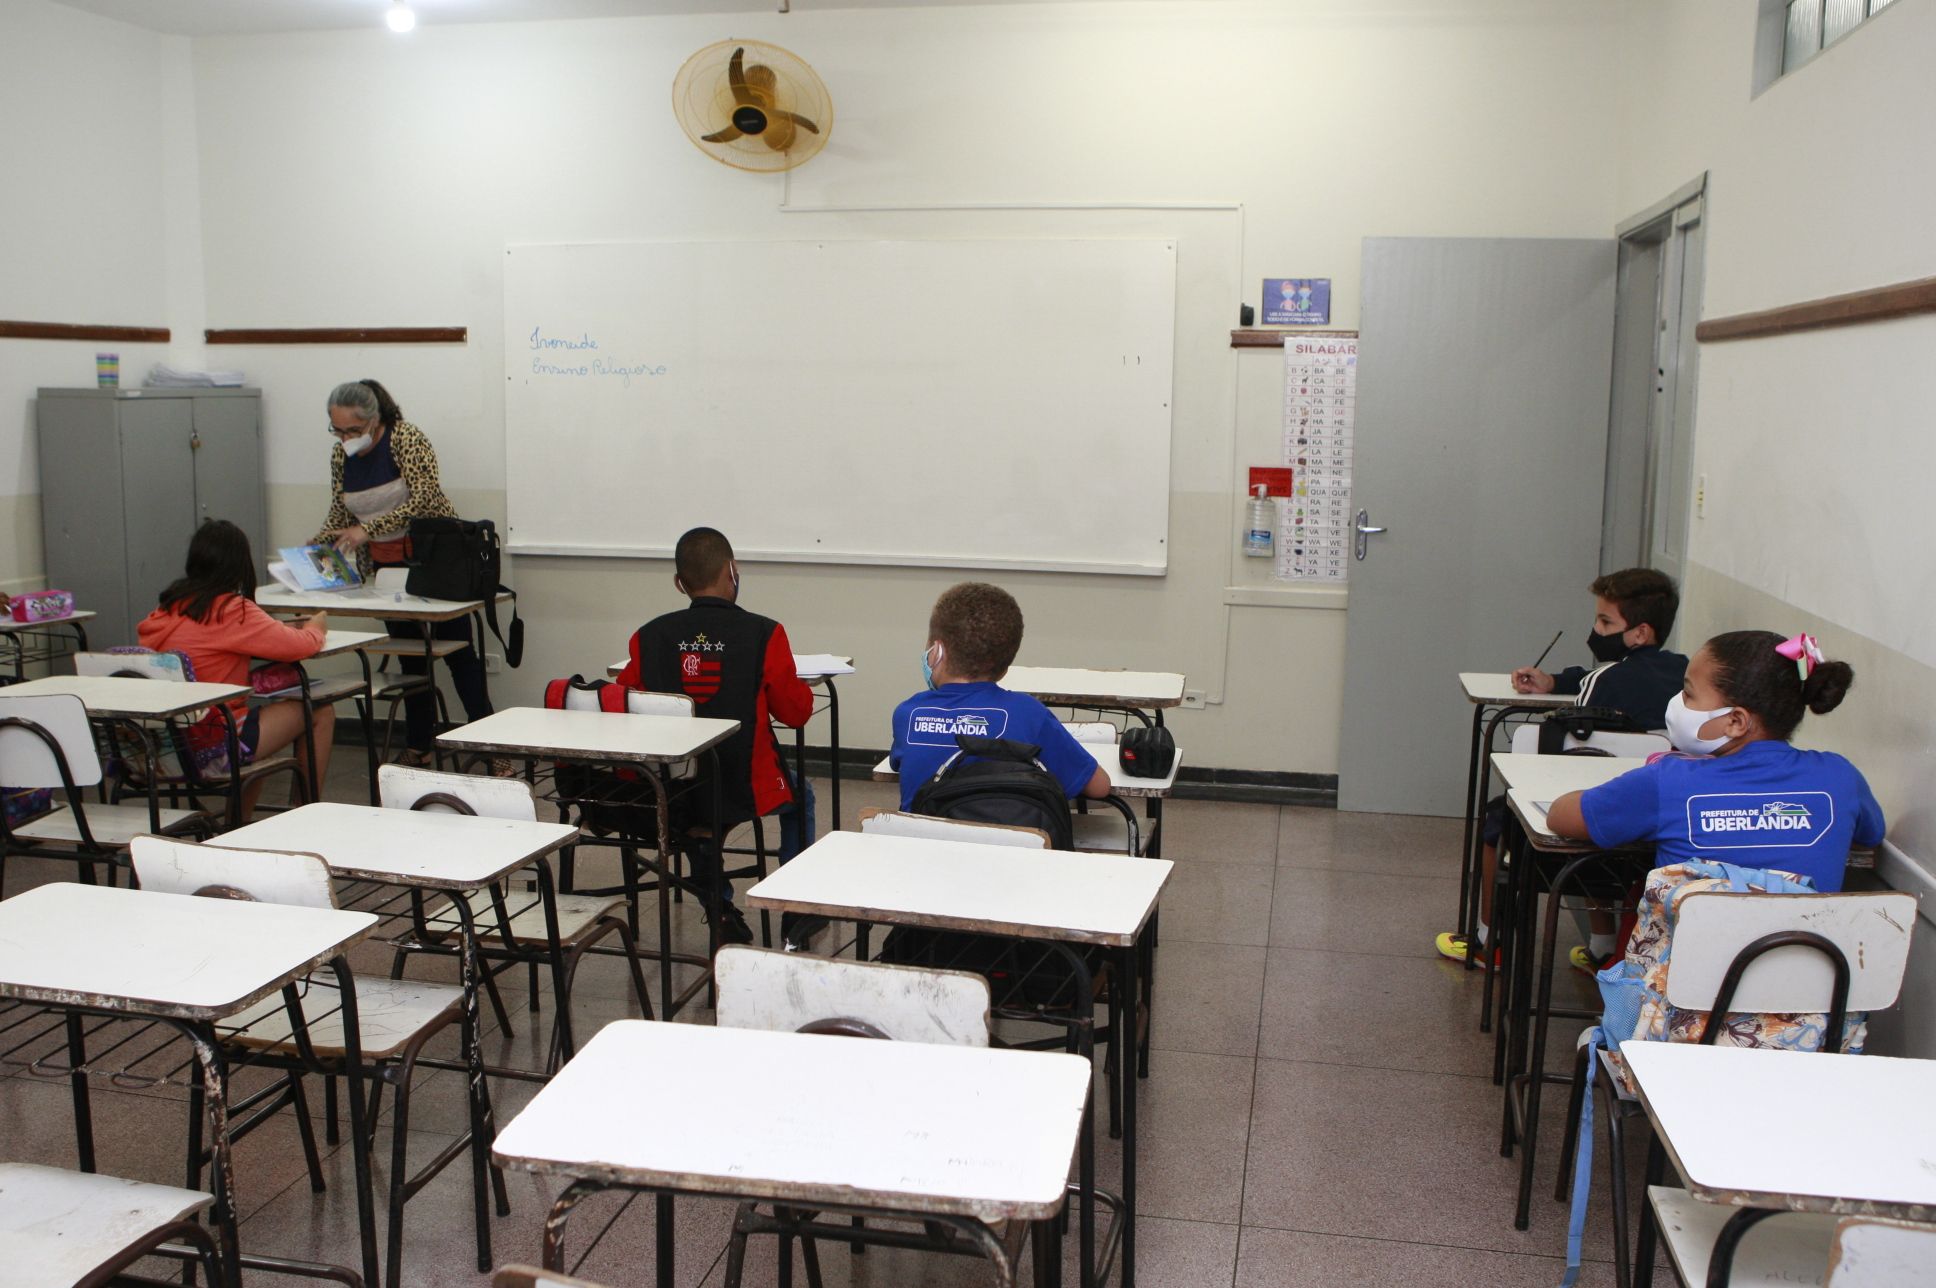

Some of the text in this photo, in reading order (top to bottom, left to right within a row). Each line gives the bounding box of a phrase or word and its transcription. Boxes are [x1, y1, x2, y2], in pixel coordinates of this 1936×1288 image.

[532, 357, 588, 376] Ensino
[1700, 808, 1759, 818] PREFEITURA DE
